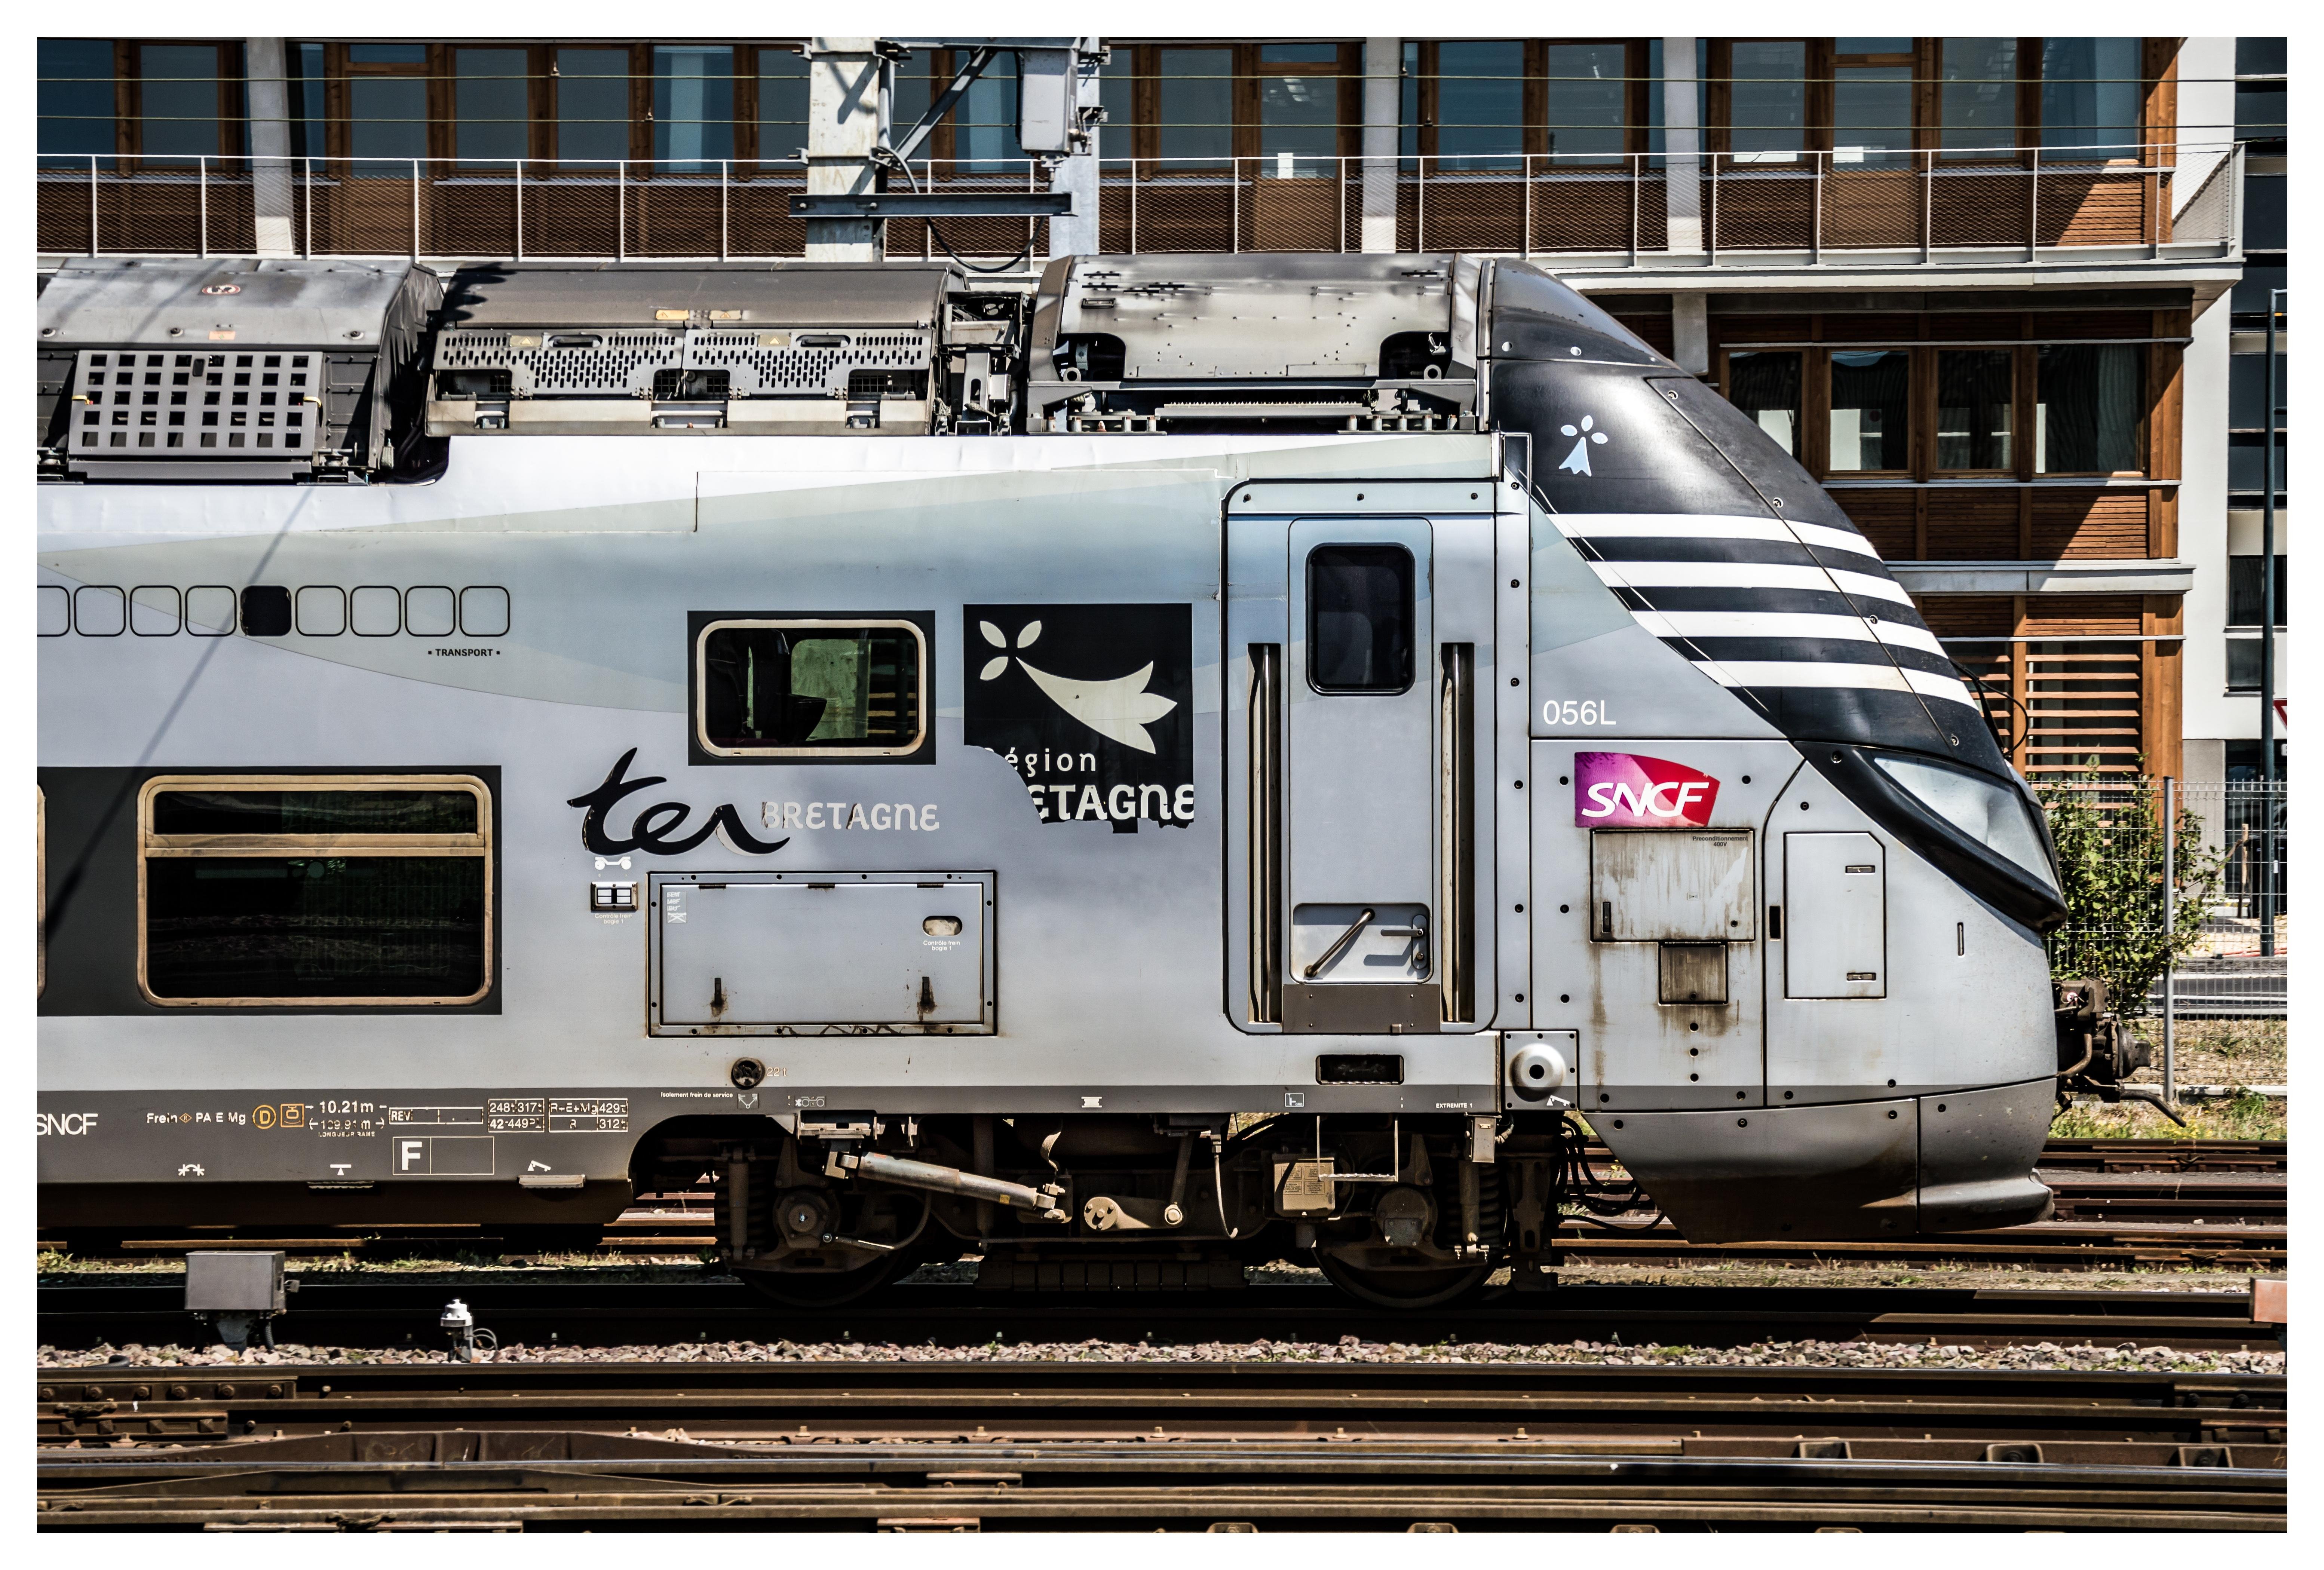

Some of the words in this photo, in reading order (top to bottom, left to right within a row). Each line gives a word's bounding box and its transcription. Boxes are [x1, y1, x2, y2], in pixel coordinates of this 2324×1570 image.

[435, 648, 493, 657] TRANSPORT
[1543, 700, 1616, 725] 056L
[984, 747, 1096, 777] égion
[566, 747, 790, 856] ter
[761, 801, 940, 831] BRETAGNE
[1027, 784, 1194, 820] ETAGNE
[1581, 782, 1710, 818] SNCF
[767, 1067, 780, 1077] 22
[783, 1067, 786, 1077] t
[37, 1113, 98, 1135] SNCF
[147, 1113, 178, 1123] Frein
[196, 1112, 212, 1123] PA
[216, 1112, 224, 1123] E
[228, 1112, 246, 1125] Mg
[260, 1110, 271, 1124] D
[391, 1111, 411, 1121] REV
[401, 1141, 423, 1170] F
